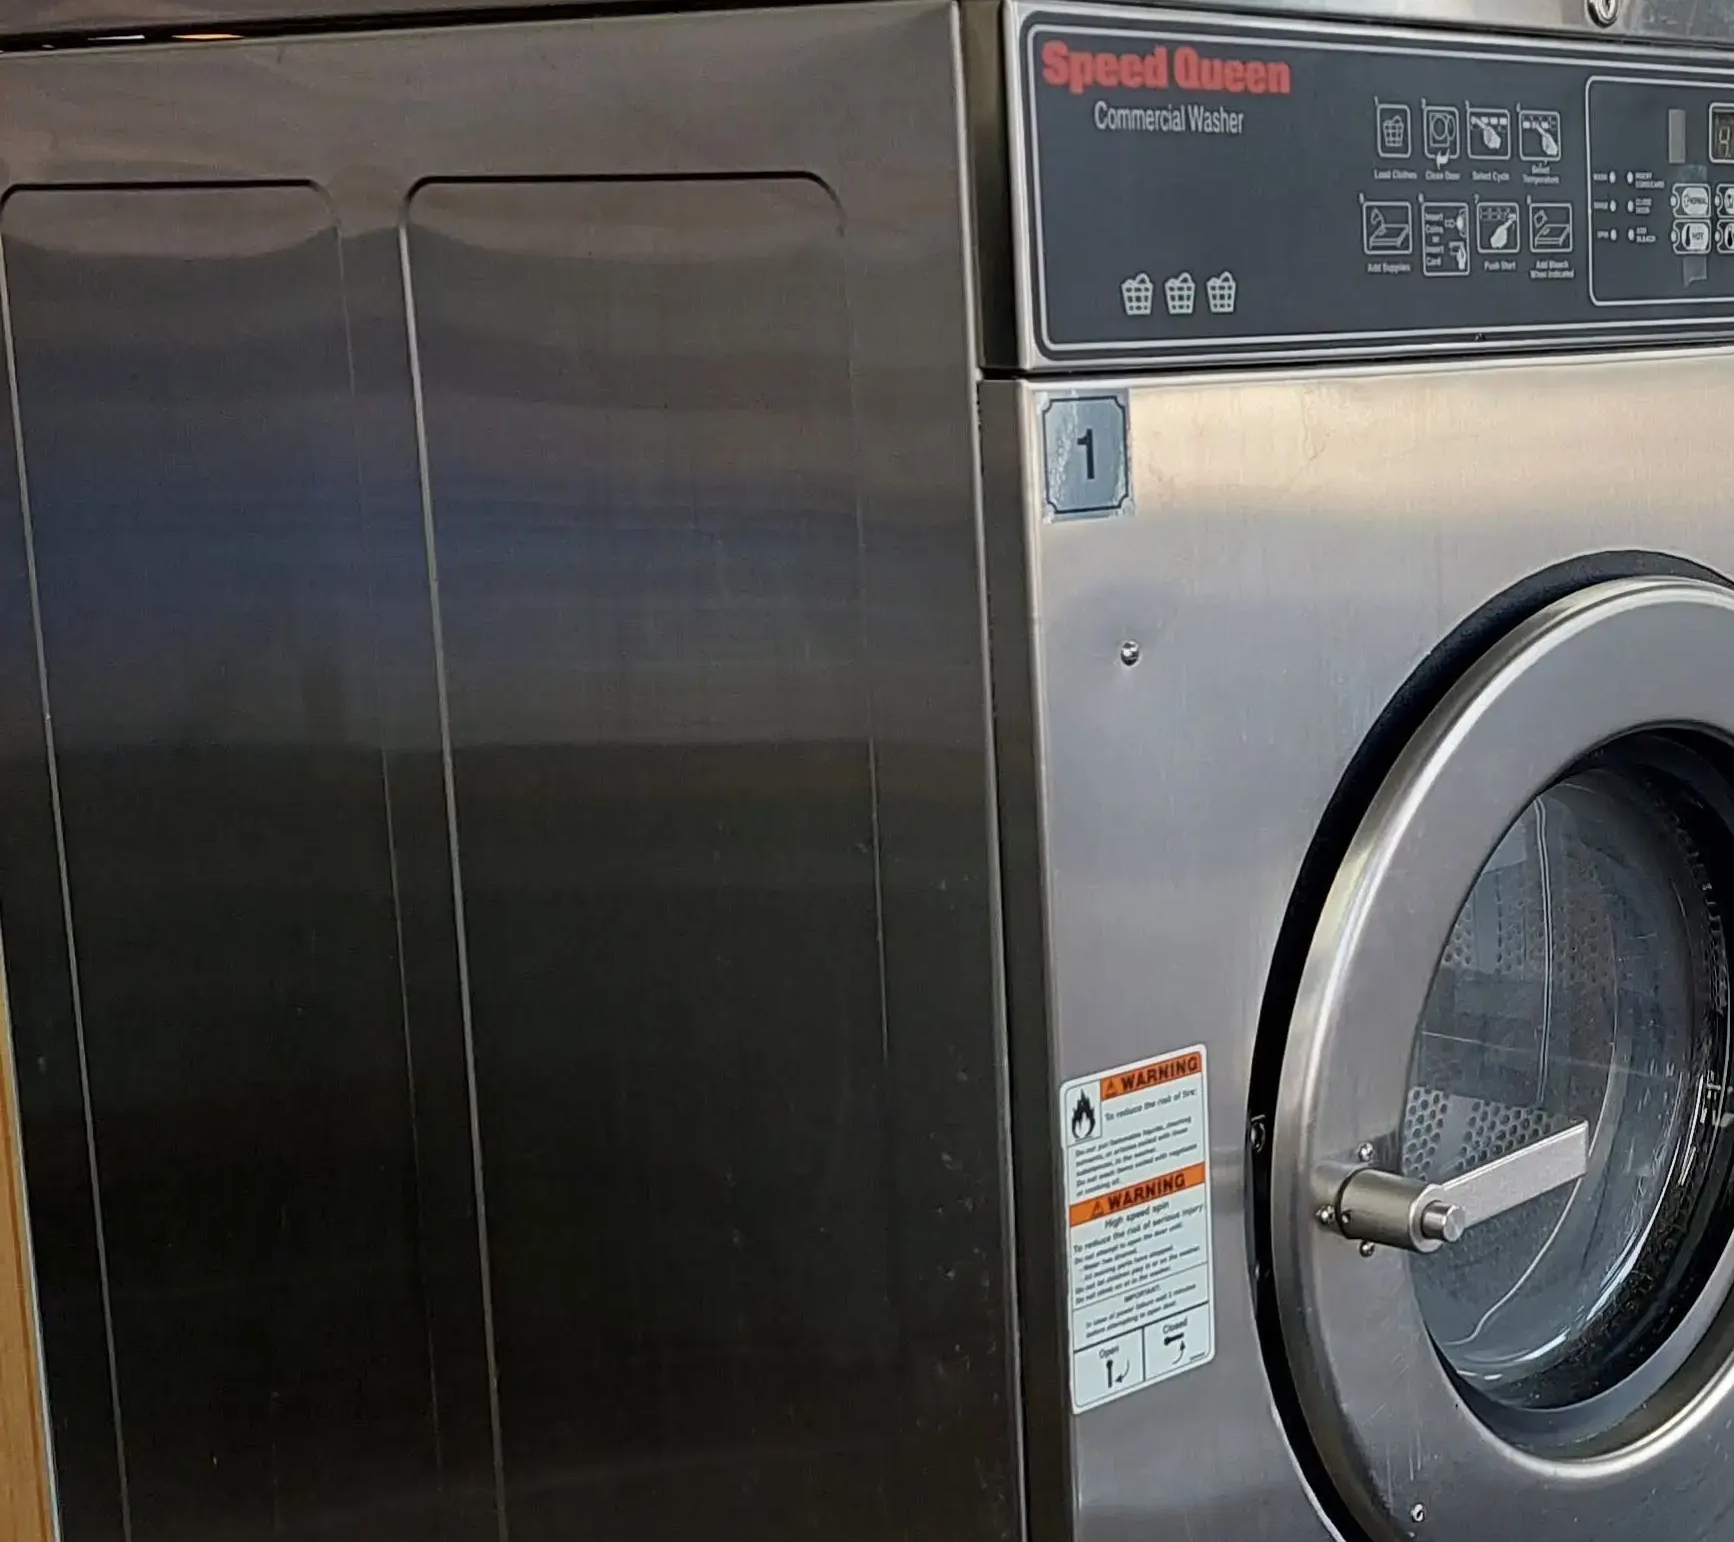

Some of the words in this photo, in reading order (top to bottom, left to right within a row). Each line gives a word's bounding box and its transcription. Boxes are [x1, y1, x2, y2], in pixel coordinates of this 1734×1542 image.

[1042, 39, 1168, 95] Speed
[1174, 46, 1291, 94] Queen
[1094, 100, 1185, 132] Commercial
[1189, 104, 1245, 134] Washer
[1691, 232, 1704, 241] HOT
[1426, 257, 1441, 266] Card
[1077, 429, 1095, 480] 1
[1122, 1057, 1197, 1091] WARNING
[1116, 1106, 1142, 1117] reduce
[1144, 1101, 1156, 1109] the
[1158, 1095, 1171, 1105] risk
[1108, 1174, 1184, 1210] WARNING
[1105, 1217, 1123, 1228] High
[1126, 1207, 1150, 1221] speed
[1152, 1202, 1169, 1213] spin
[1085, 1236, 1111, 1249] reduce
[1113, 1231, 1125, 1240] the
[1127, 1225, 1140, 1235] risk
[1153, 1212, 1180, 1226] serious
[1163, 1317, 1187, 1334] Closed
[1099, 1346, 1119, 1358] Open
